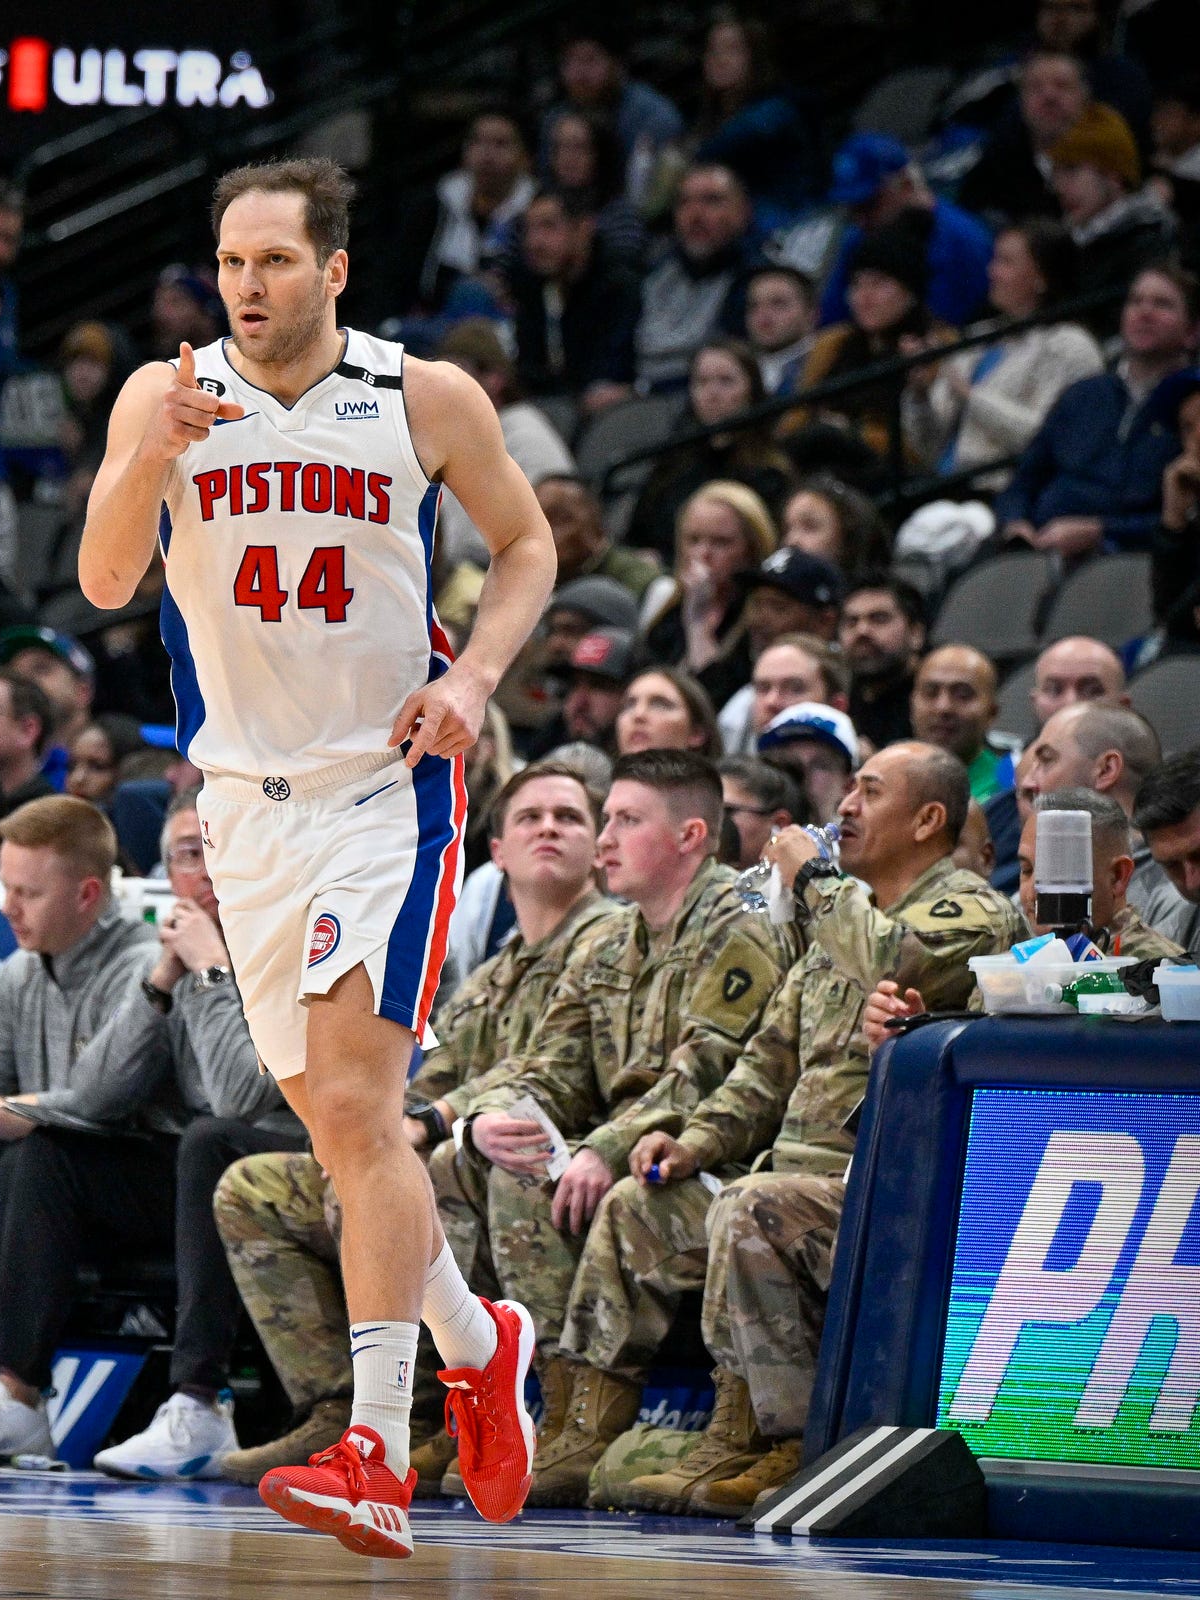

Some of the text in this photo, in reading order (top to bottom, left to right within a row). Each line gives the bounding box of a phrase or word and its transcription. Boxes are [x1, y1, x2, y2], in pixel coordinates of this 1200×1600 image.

[362, 371, 376, 385] 16
[202, 380, 218, 395] 6
[335, 400, 379, 416] UWM
[193, 461, 393, 525] PISTONS
[233, 544, 355, 623] 44
